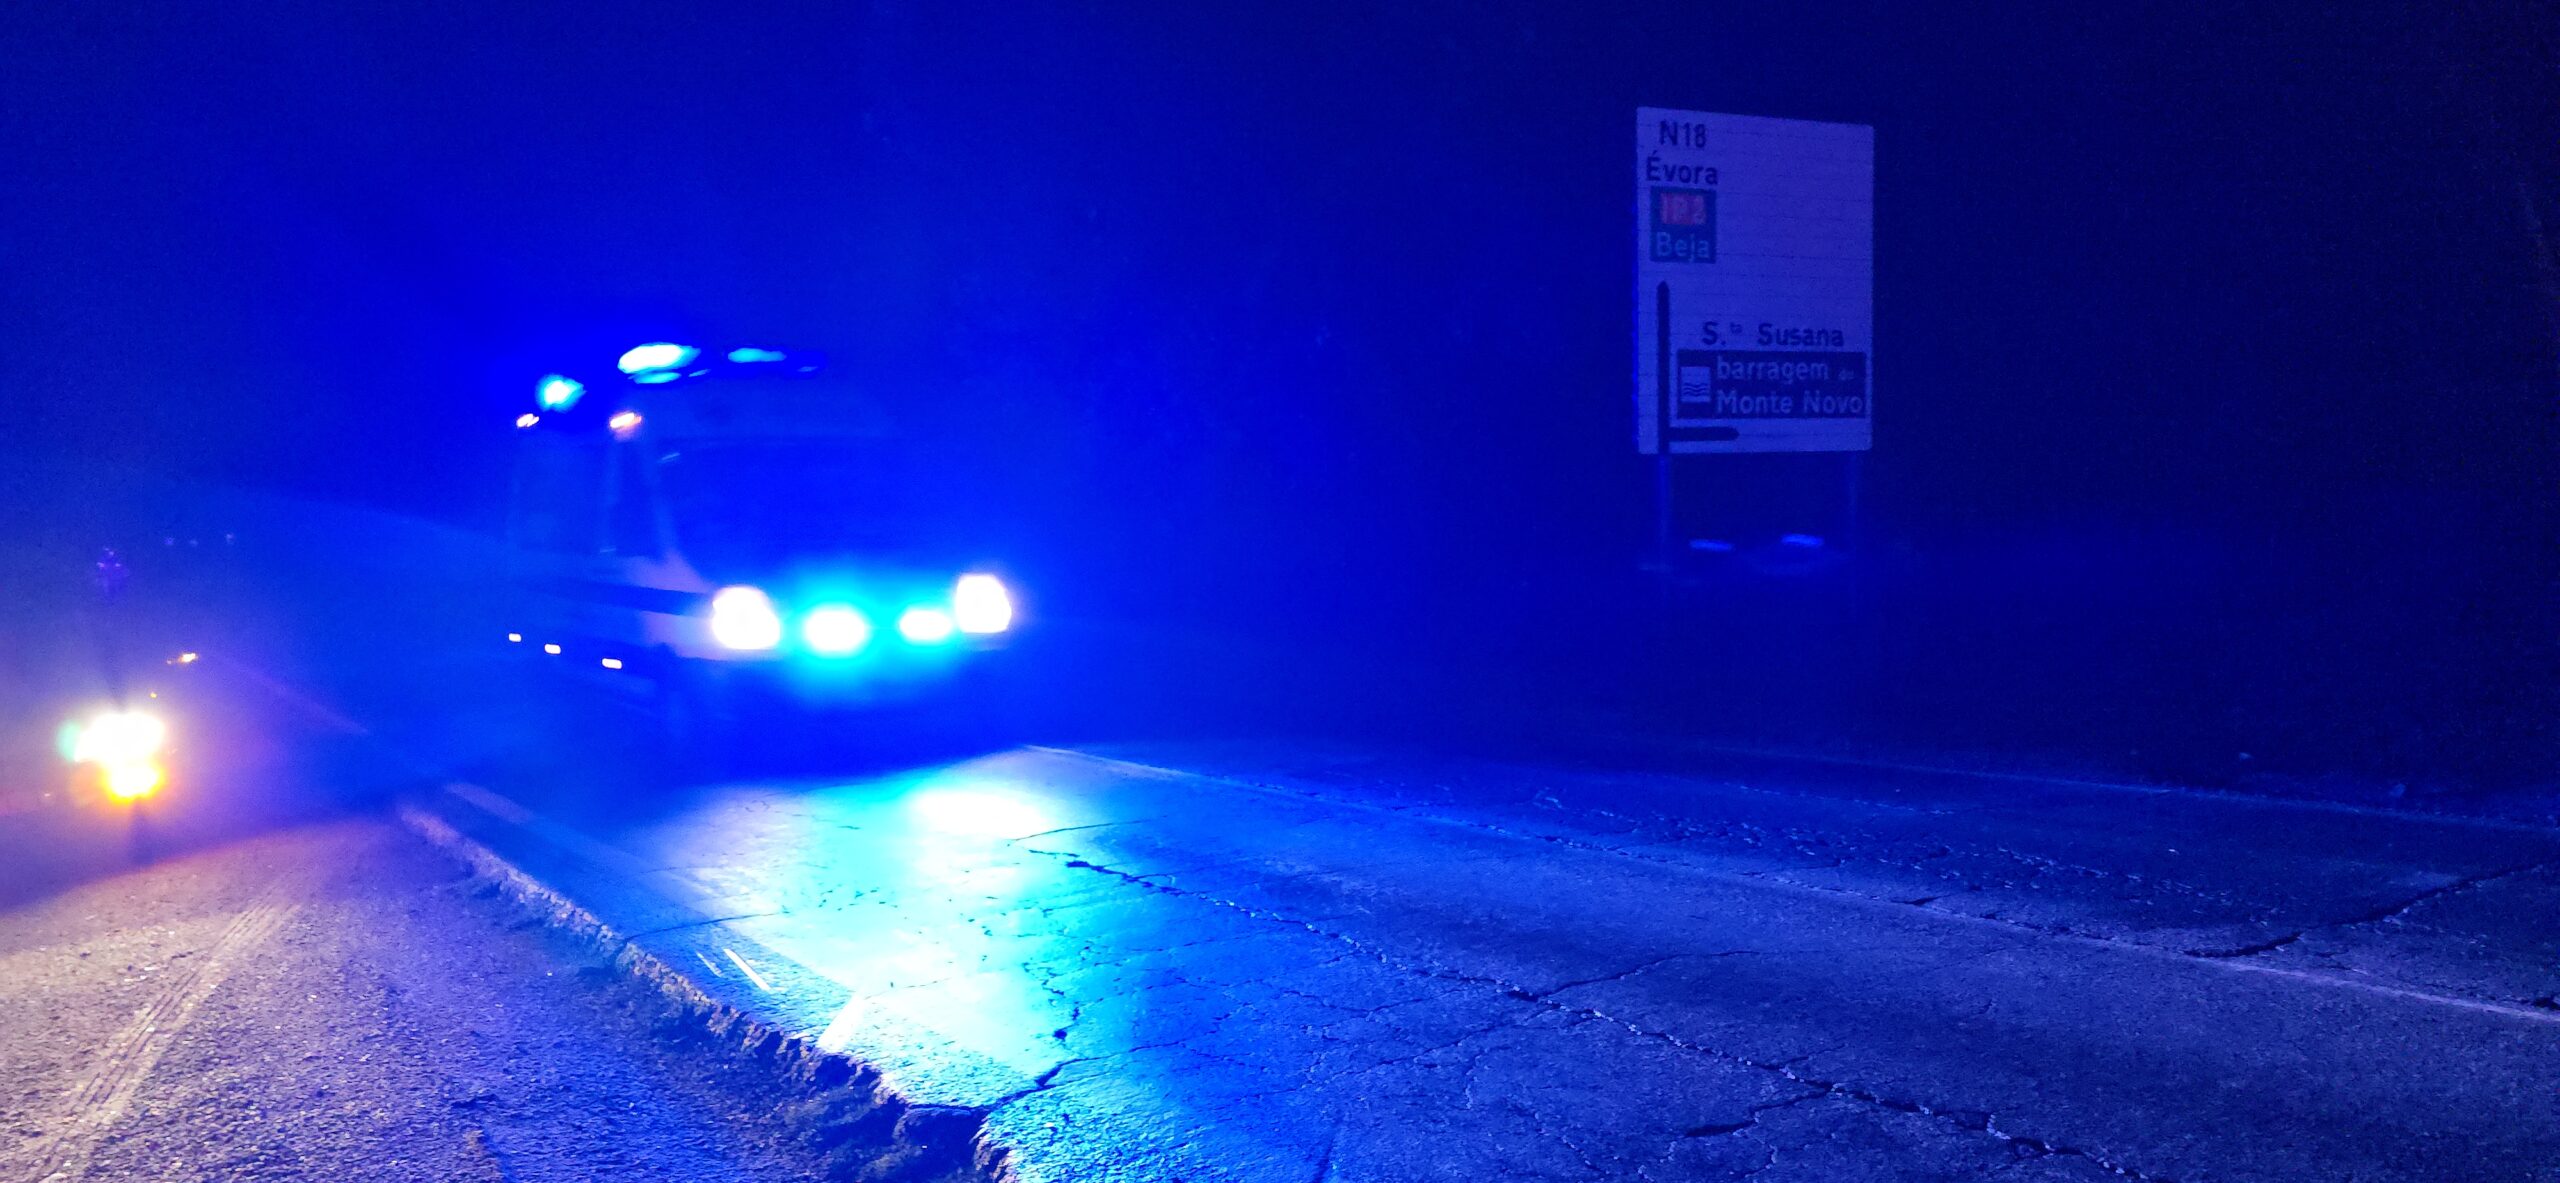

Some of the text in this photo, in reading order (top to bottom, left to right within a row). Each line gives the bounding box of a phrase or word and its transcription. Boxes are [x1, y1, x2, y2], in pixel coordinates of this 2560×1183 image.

[1659, 120, 1707, 148] N18
[1646, 150, 1719, 185] Évora
[1661, 193, 1706, 225] IP2
[1656, 231, 1710, 262] Beja
[1757, 322, 1844, 347] Susana
[1716, 355, 1829, 385] barragem
[1716, 390, 1863, 414] Monte Novo
